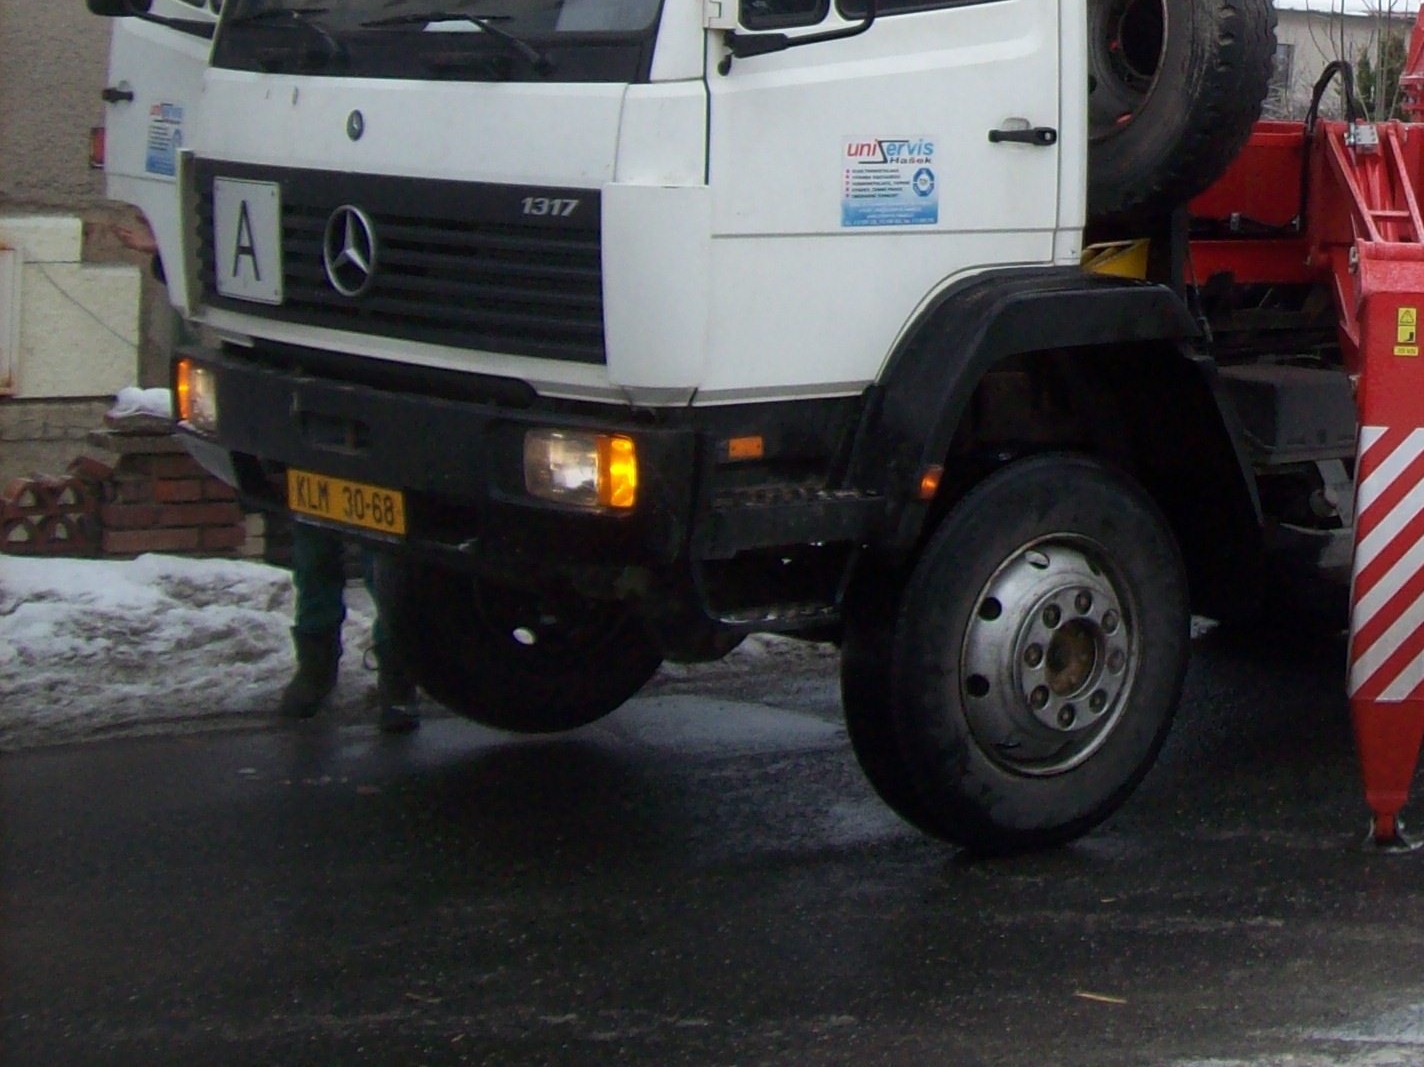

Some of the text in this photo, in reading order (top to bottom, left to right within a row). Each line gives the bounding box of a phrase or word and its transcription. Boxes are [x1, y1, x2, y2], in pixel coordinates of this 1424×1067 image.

[521, 197, 579, 217] 1317
[232, 199, 261, 282] A
[296, 475, 395, 527] KLM 30-68
